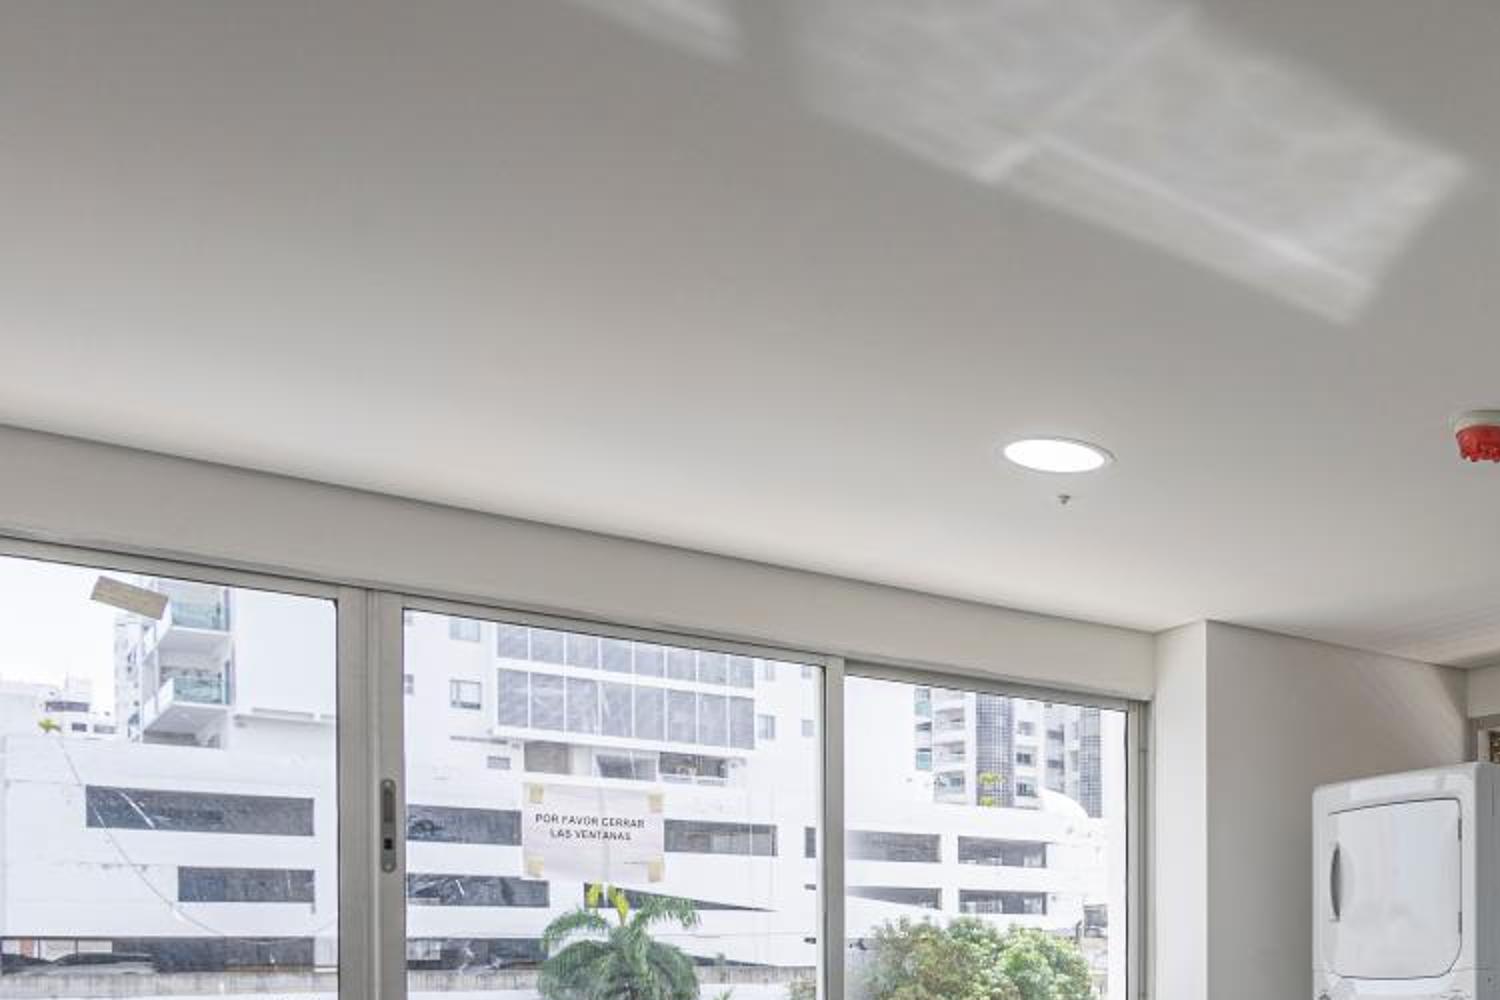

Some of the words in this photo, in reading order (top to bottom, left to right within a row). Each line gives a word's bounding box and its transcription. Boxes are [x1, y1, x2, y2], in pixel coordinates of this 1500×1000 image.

[535, 813, 559, 823] POR
[562, 815, 598, 827] FAVOR
[602, 817, 645, 828] CERRAR
[550, 828, 573, 839] LAS
[575, 830, 631, 840] VENTANAS
